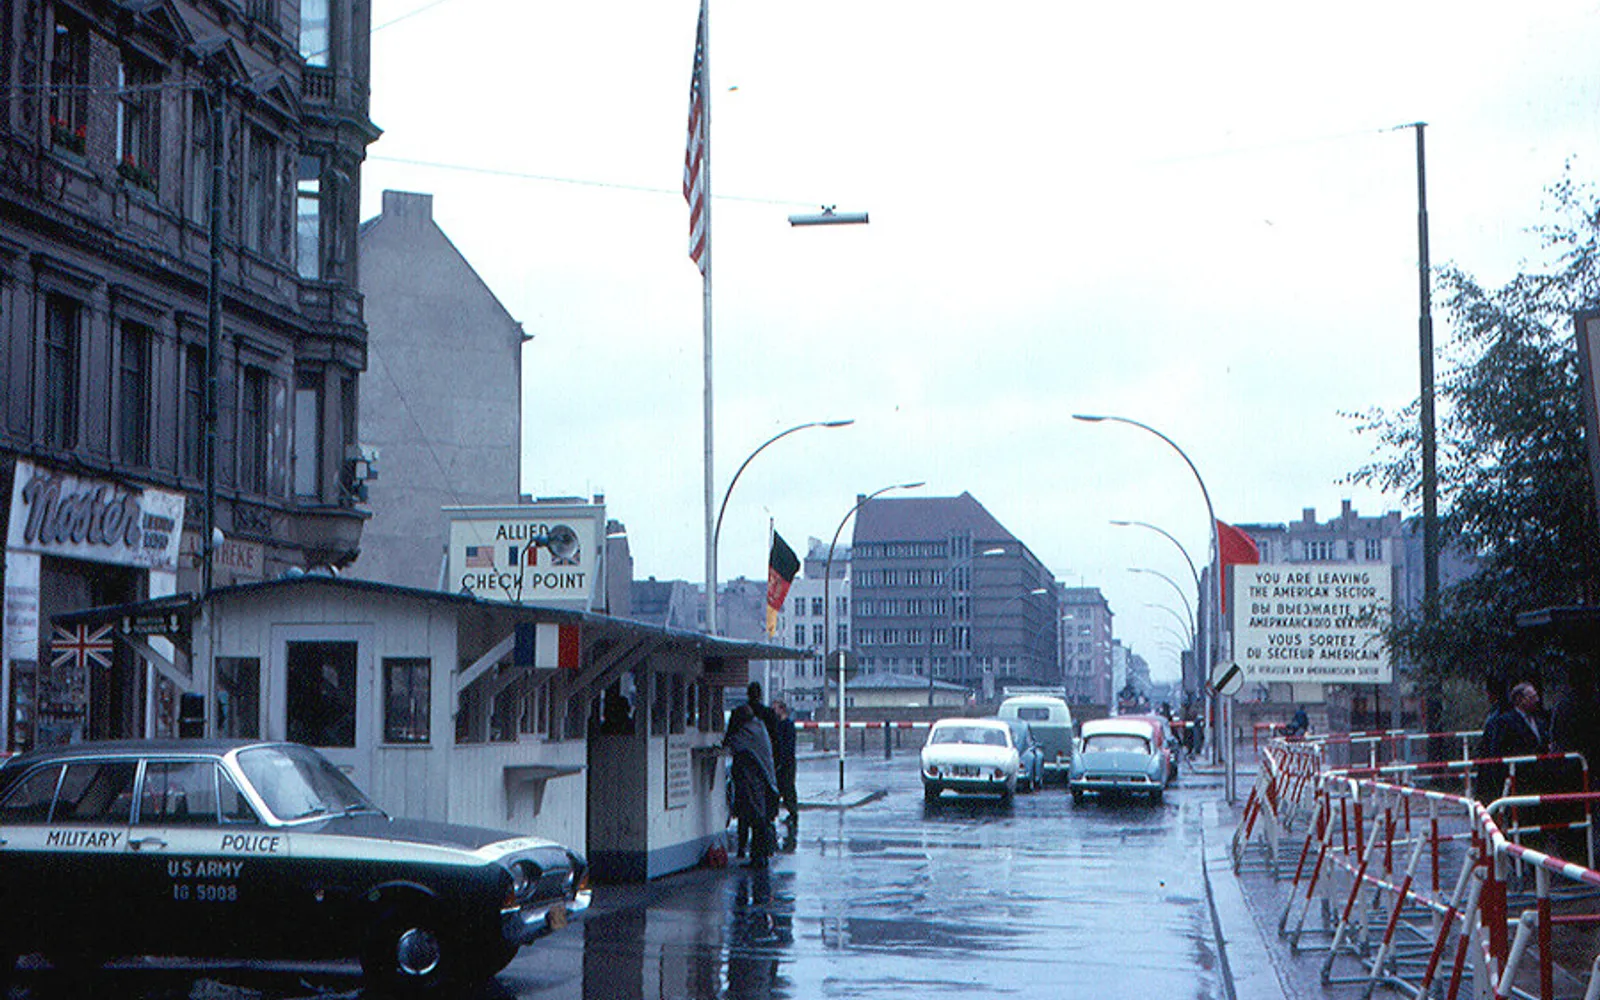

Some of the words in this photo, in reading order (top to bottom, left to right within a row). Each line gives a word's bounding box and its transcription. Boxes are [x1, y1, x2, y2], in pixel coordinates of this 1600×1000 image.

[496, 523, 550, 541] ALLIED
[461, 572, 523, 589] CHECK
[533, 573, 586, 589] POINT
[1255, 572, 1280, 584] YOU
[1287, 572, 1310, 584] ARE
[1318, 572, 1370, 585] LEAVING
[1249, 585, 1268, 597] THE
[1272, 586, 1330, 598] AMERICAN
[1335, 586, 1377, 598] SECTOR
[1267, 633, 1302, 646] VOUS
[1308, 634, 1357, 647] SORTEZ
[1246, 647, 1262, 659] DU
[1267, 647, 1315, 660] SECTEUR
[1319, 648, 1380, 661] AMERICAIN
[46, 831, 123, 848] MILITARY
[220, 834, 280, 853] POLICE
[195, 859, 245, 878] ARMY
